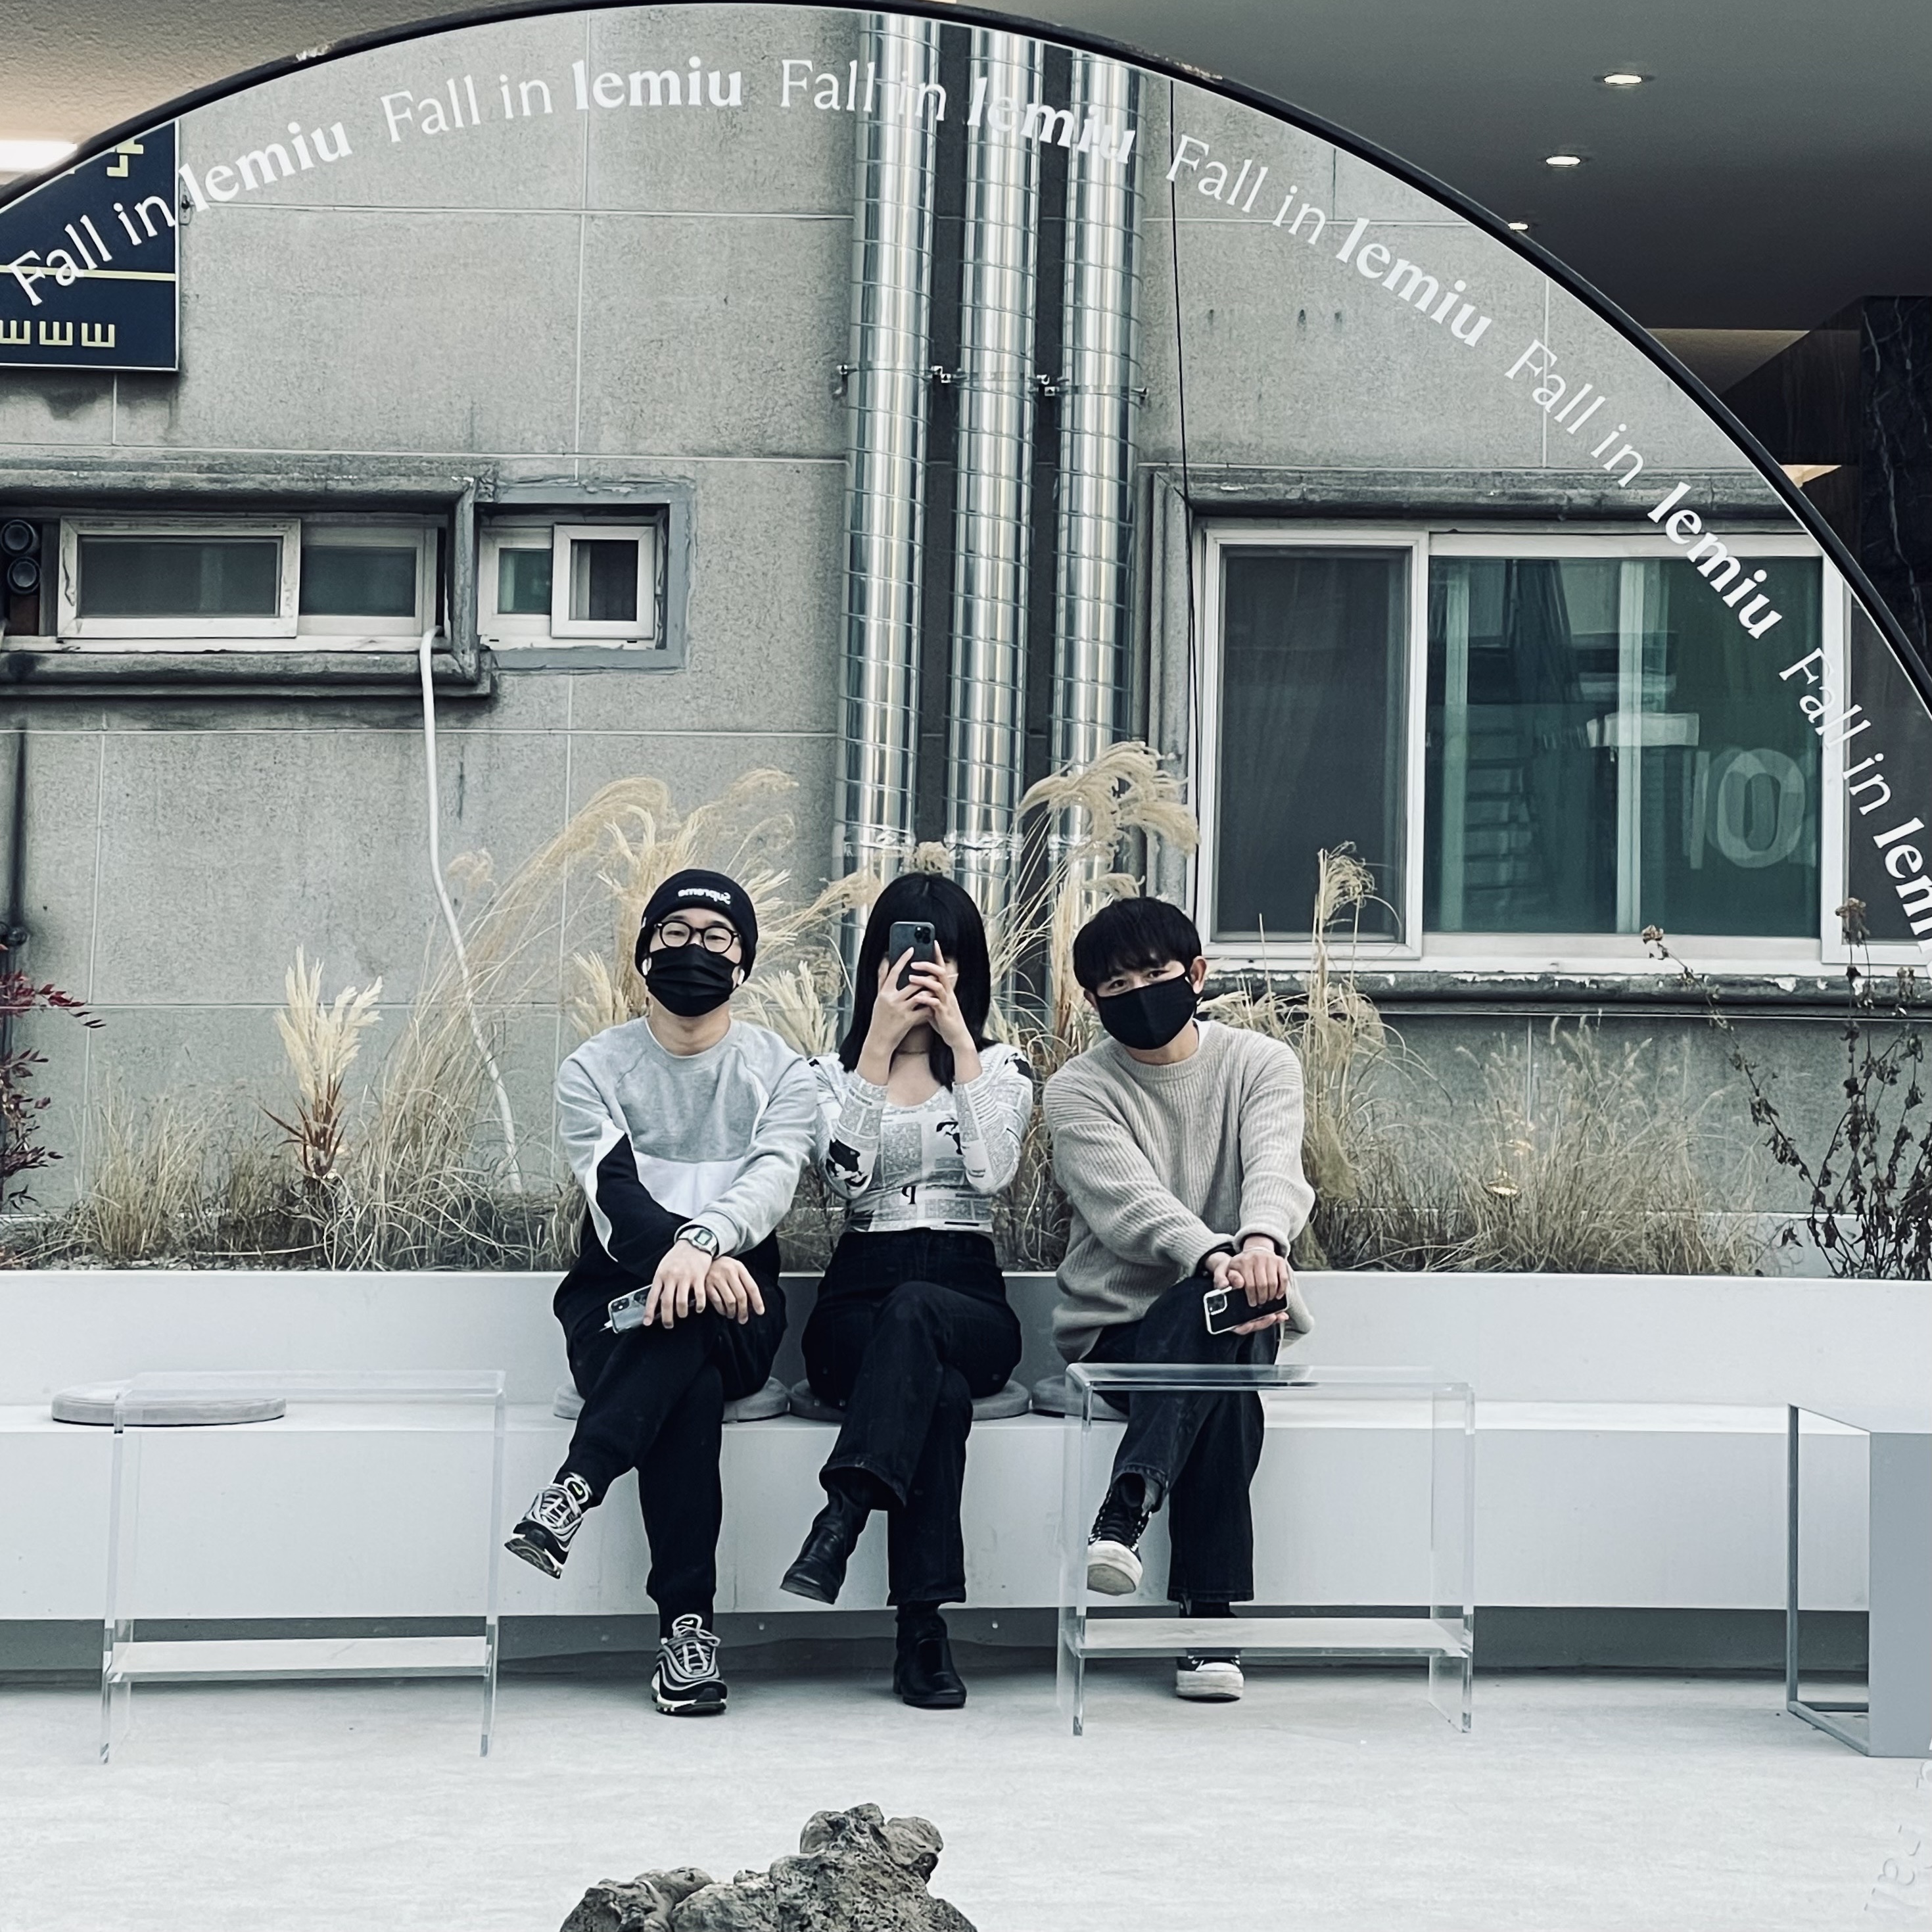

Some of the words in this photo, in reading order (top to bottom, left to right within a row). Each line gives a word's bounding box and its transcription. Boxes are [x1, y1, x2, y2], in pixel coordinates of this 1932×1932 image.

[380, 74, 481, 143] Fall
[499, 74, 553, 120] in
[573, 57, 743, 110] lemiu
[781, 59, 876, 112] Fall
[898, 70, 947, 121] in
[968, 77, 1136, 164] lemiu
[7, 215, 112, 306] Fall
[113, 196, 176, 246] in
[178, 121, 353, 214] lemiu
[1166, 134, 1268, 213] Fall
[1273, 185, 1326, 245] in
[1336, 217, 1492, 347] lemiu
[1504, 339, 1606, 435] Fall
[1590, 423, 1644, 488] in
[1647, 481, 1782, 639] lemiu
[1779, 648, 1872, 750] Fall
[1843, 753, 1893, 815] in
[1873, 817, 1932, 985] lem
